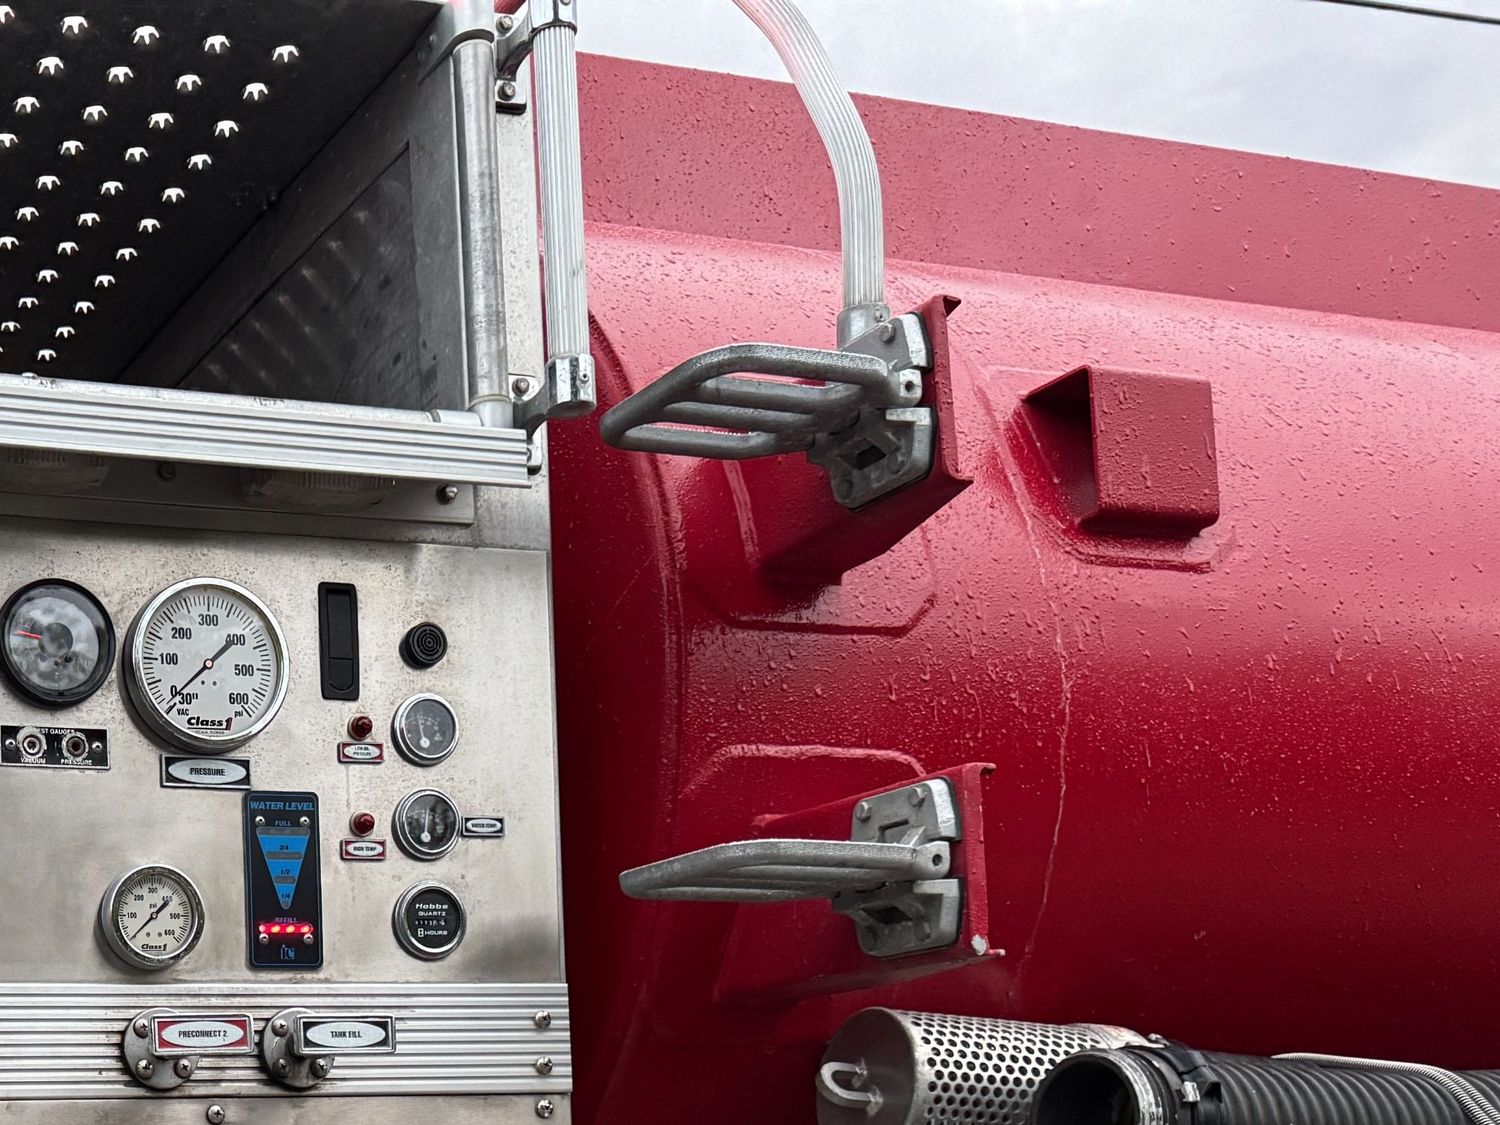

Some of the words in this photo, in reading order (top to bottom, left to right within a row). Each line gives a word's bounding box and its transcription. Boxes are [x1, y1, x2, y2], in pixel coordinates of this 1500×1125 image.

[198, 614, 218, 626] 300
[172, 627, 192, 640] 200
[225, 634, 246, 646] 400
[159, 652, 178, 666] 100
[234, 664, 254, 676] 500
[229, 692, 249, 705] 600
[176, 708, 190, 716] VAC
[234, 710, 244, 718] psi
[190, 767, 226, 776] PRESSURE
[250, 801, 284, 810] WATER
[285, 802, 315, 811] LEVEL
[178, 1030, 221, 1038] PRECONNECT
[330, 1030, 346, 1038] TANK
[348, 1030, 362, 1038] FILL
